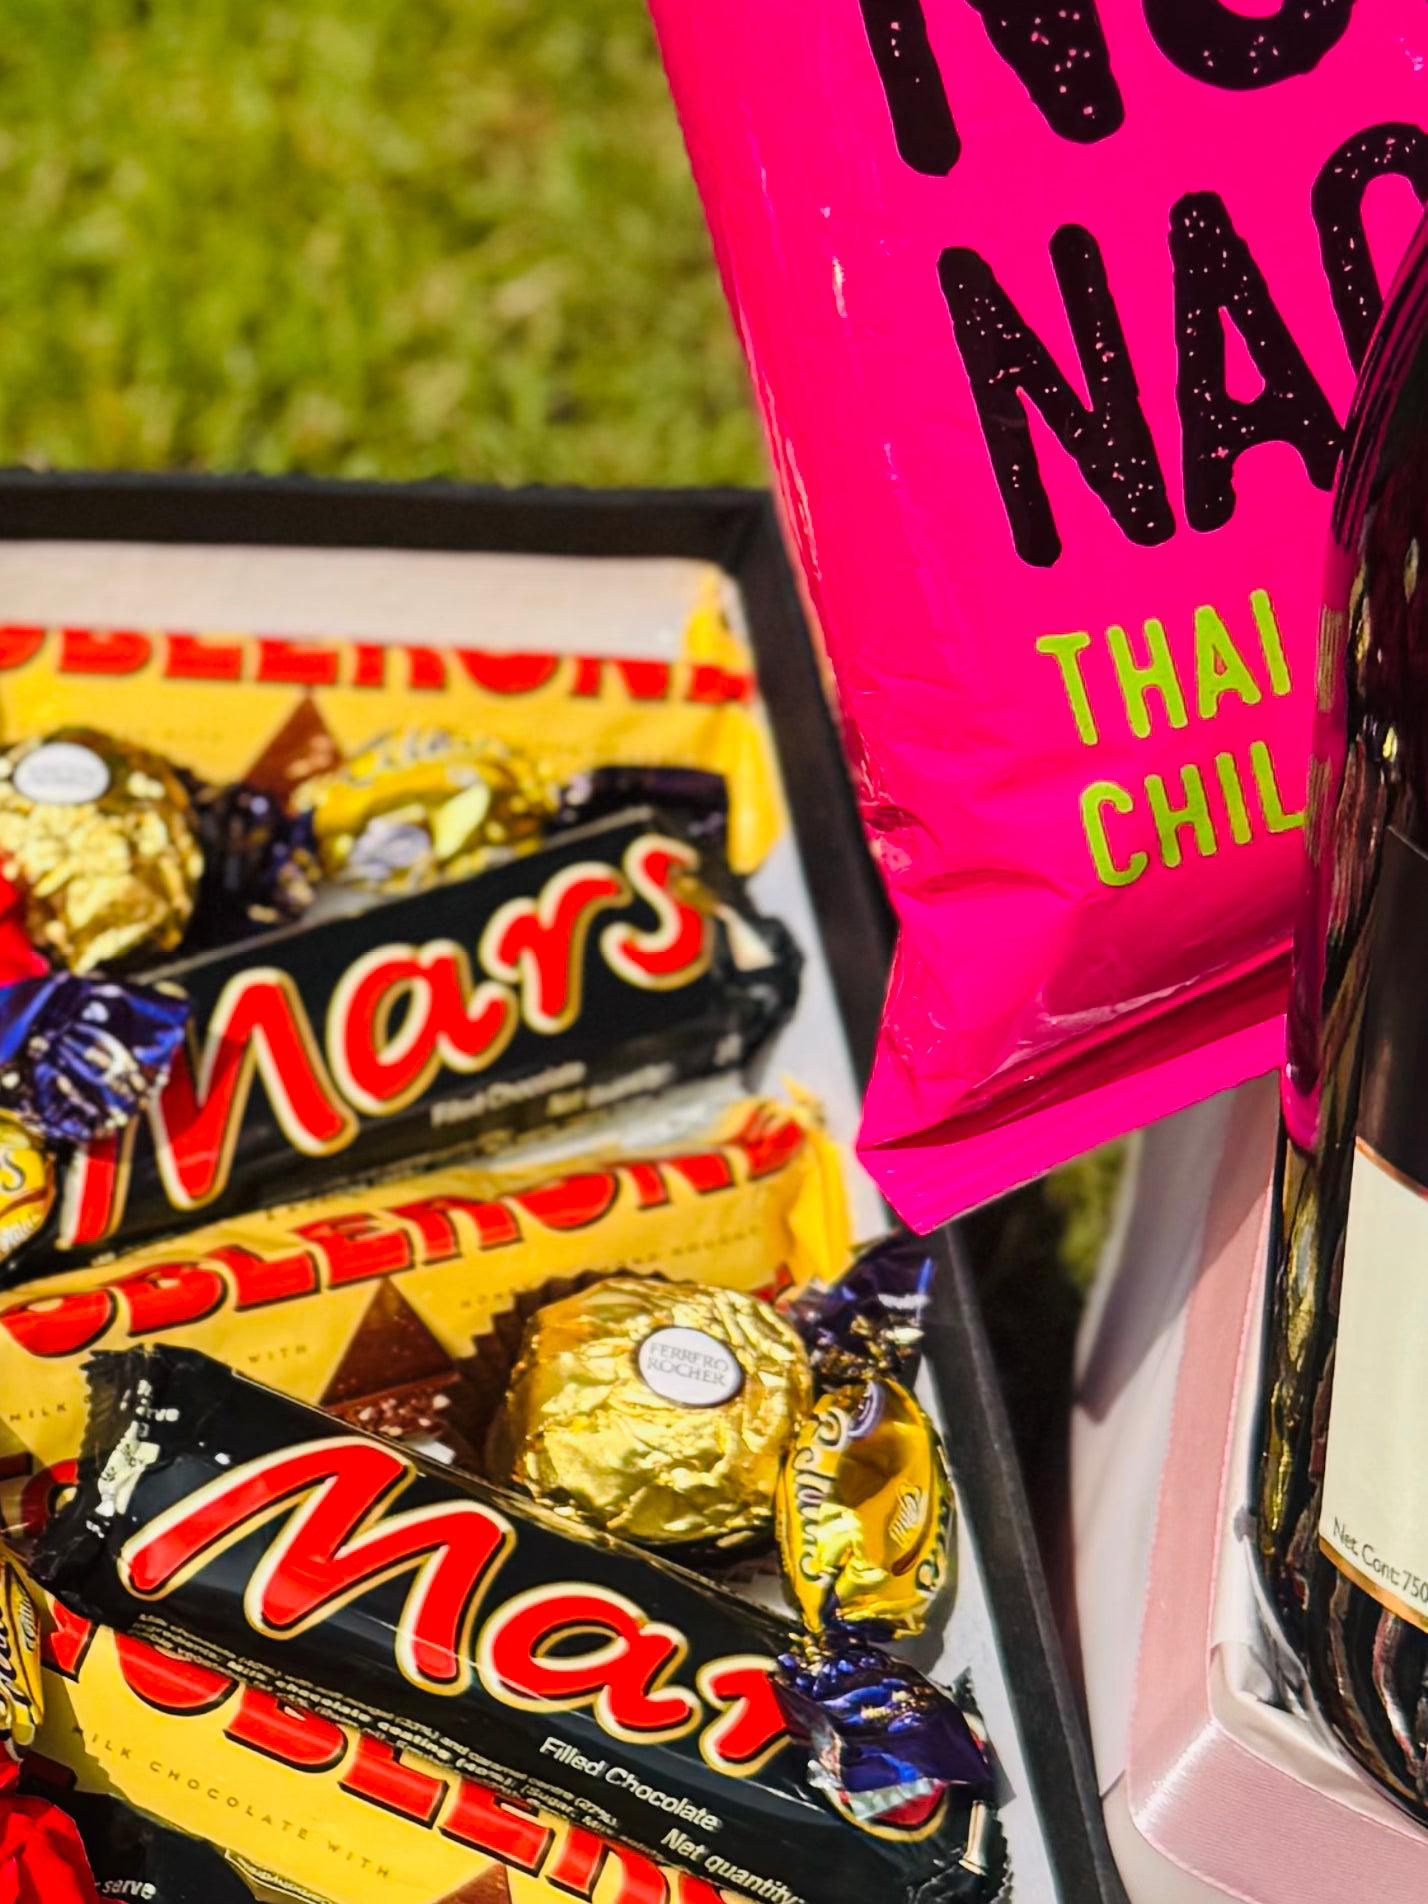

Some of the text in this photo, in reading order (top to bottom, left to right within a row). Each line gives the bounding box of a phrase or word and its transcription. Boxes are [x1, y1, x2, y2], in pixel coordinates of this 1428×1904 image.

[1036, 589, 1293, 749] THAI
[55, 834, 714, 1251] Mars
[248, 1344, 309, 1364] WITH
[645, 1355, 727, 1388] ROCHER
[648, 1341, 730, 1374] FERRERO
[10, 1403, 68, 1424] MILK
[117, 1436, 947, 1844] Mar
[74, 1723, 392, 1878] MILK CHOCOLATE WITH
[539, 1736, 724, 1832] Filled Chocolate
[661, 1828, 703, 1863] Net
